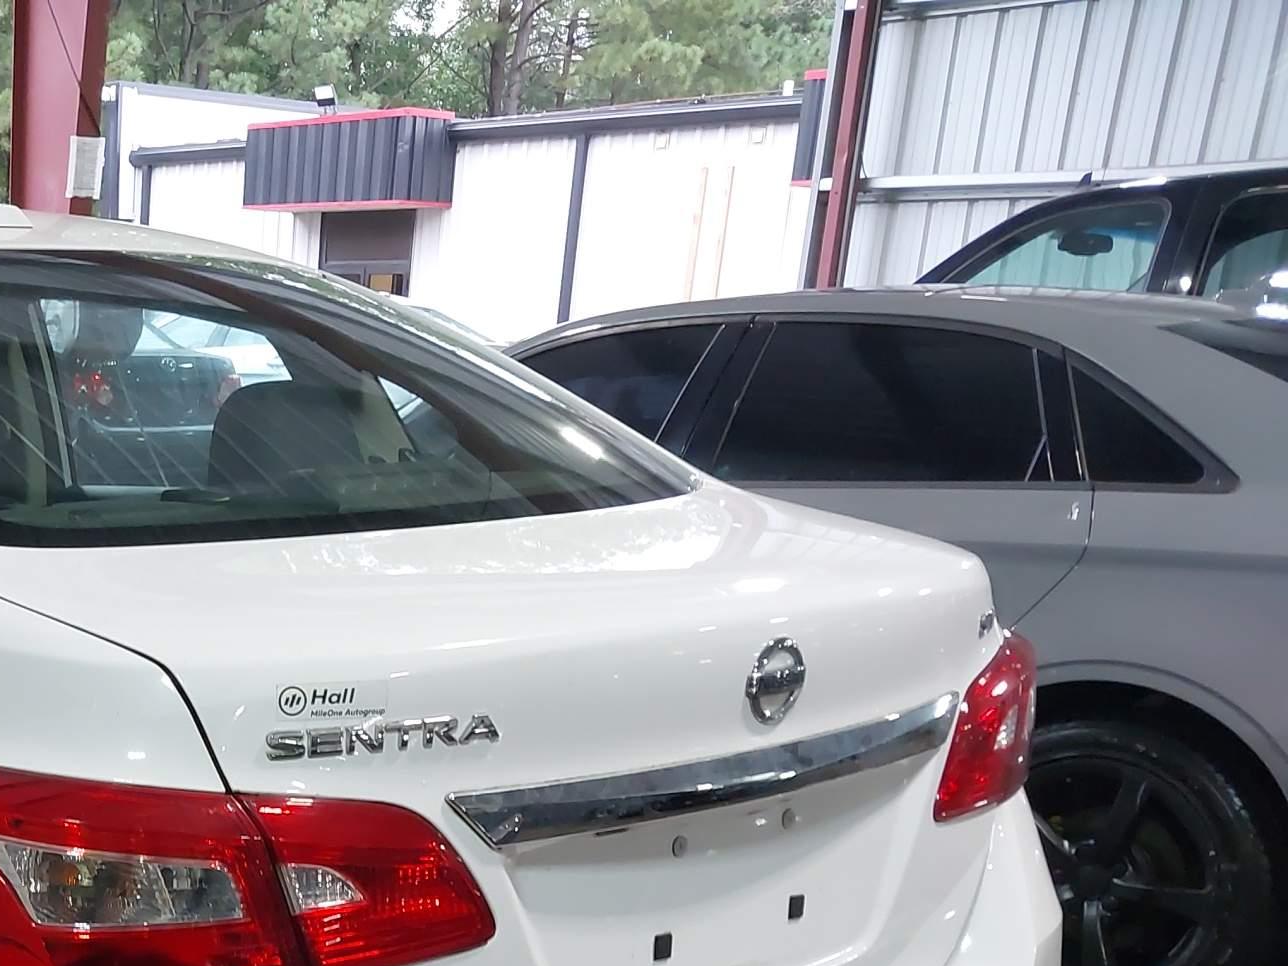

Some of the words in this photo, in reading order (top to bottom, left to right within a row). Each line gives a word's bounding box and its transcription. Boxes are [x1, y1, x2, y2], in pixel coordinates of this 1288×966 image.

[311, 687, 355, 705] Hall
[310, 709, 343, 718] MileOne
[345, 707, 386, 717] Autogroup
[265, 713, 501, 761] SENTRA
